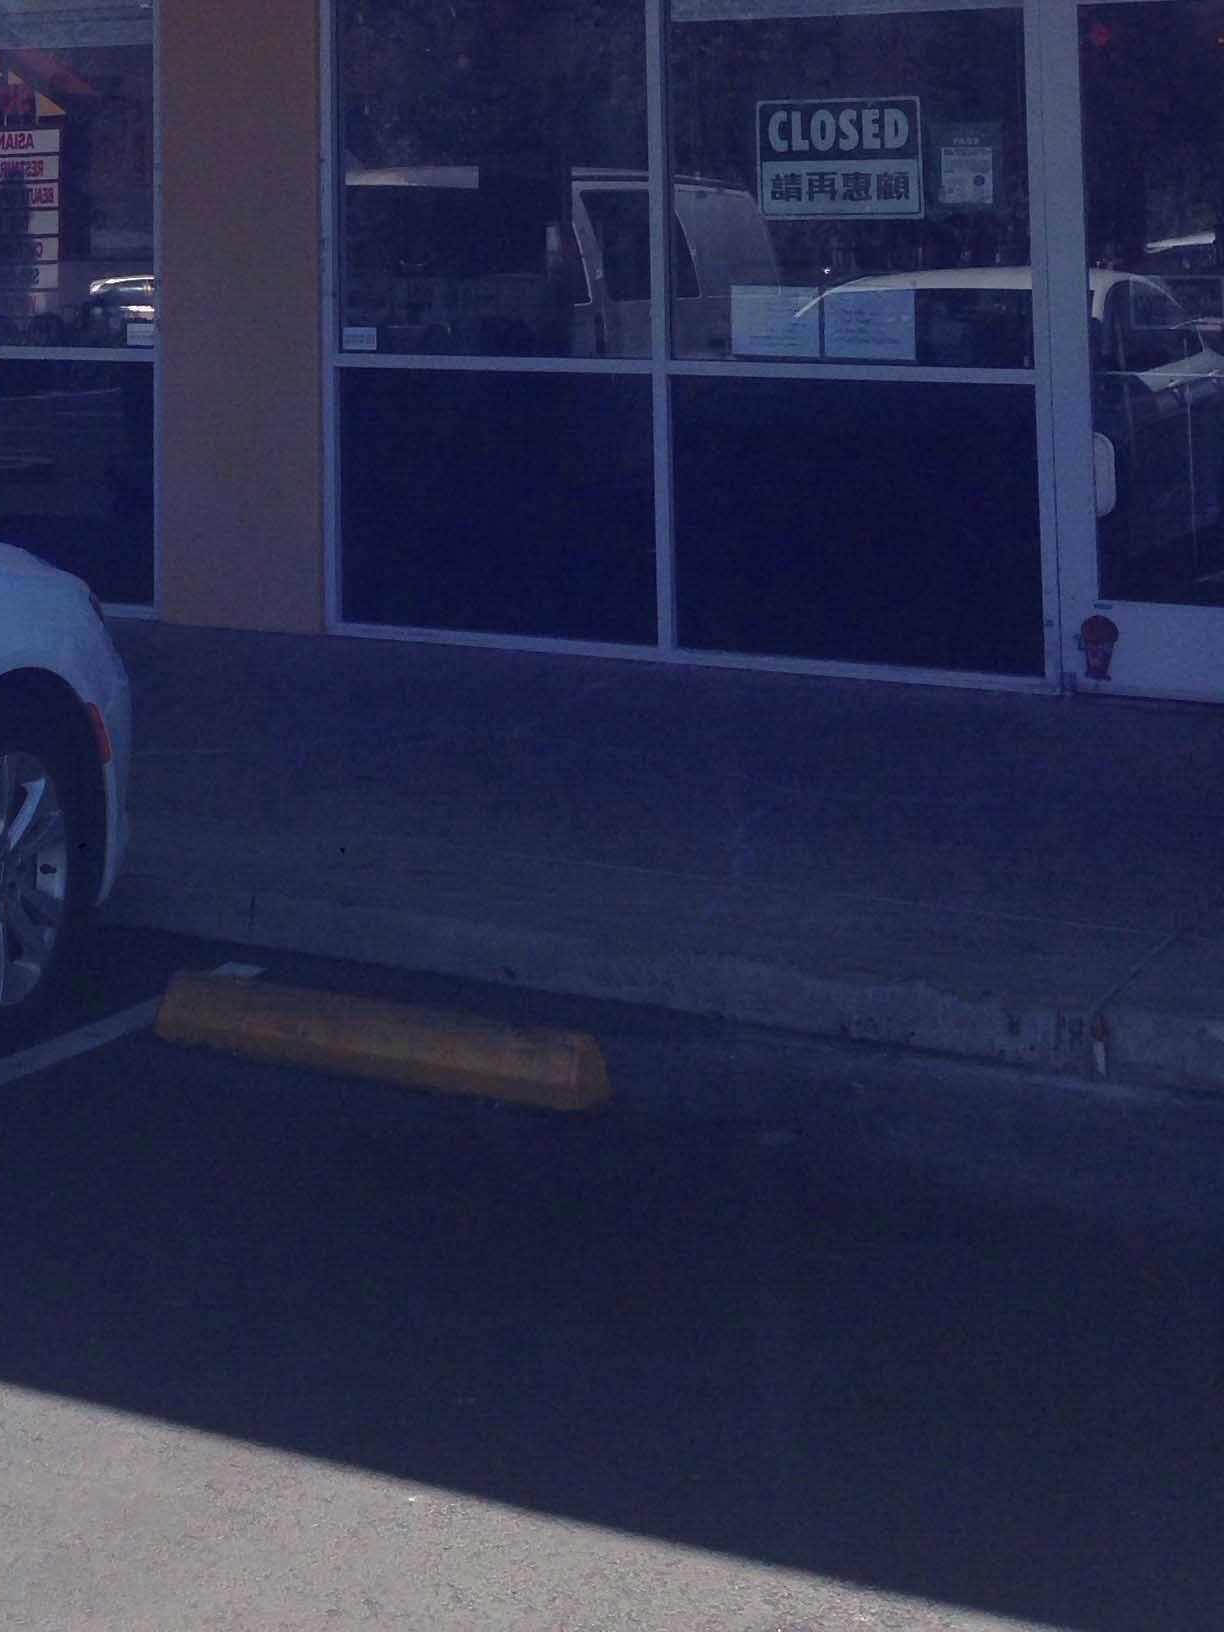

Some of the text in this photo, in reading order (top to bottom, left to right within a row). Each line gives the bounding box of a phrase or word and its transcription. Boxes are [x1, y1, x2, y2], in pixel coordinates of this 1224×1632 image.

[767, 108, 909, 152] CLOSED
[770, 171, 911, 202] 請再惠顧
